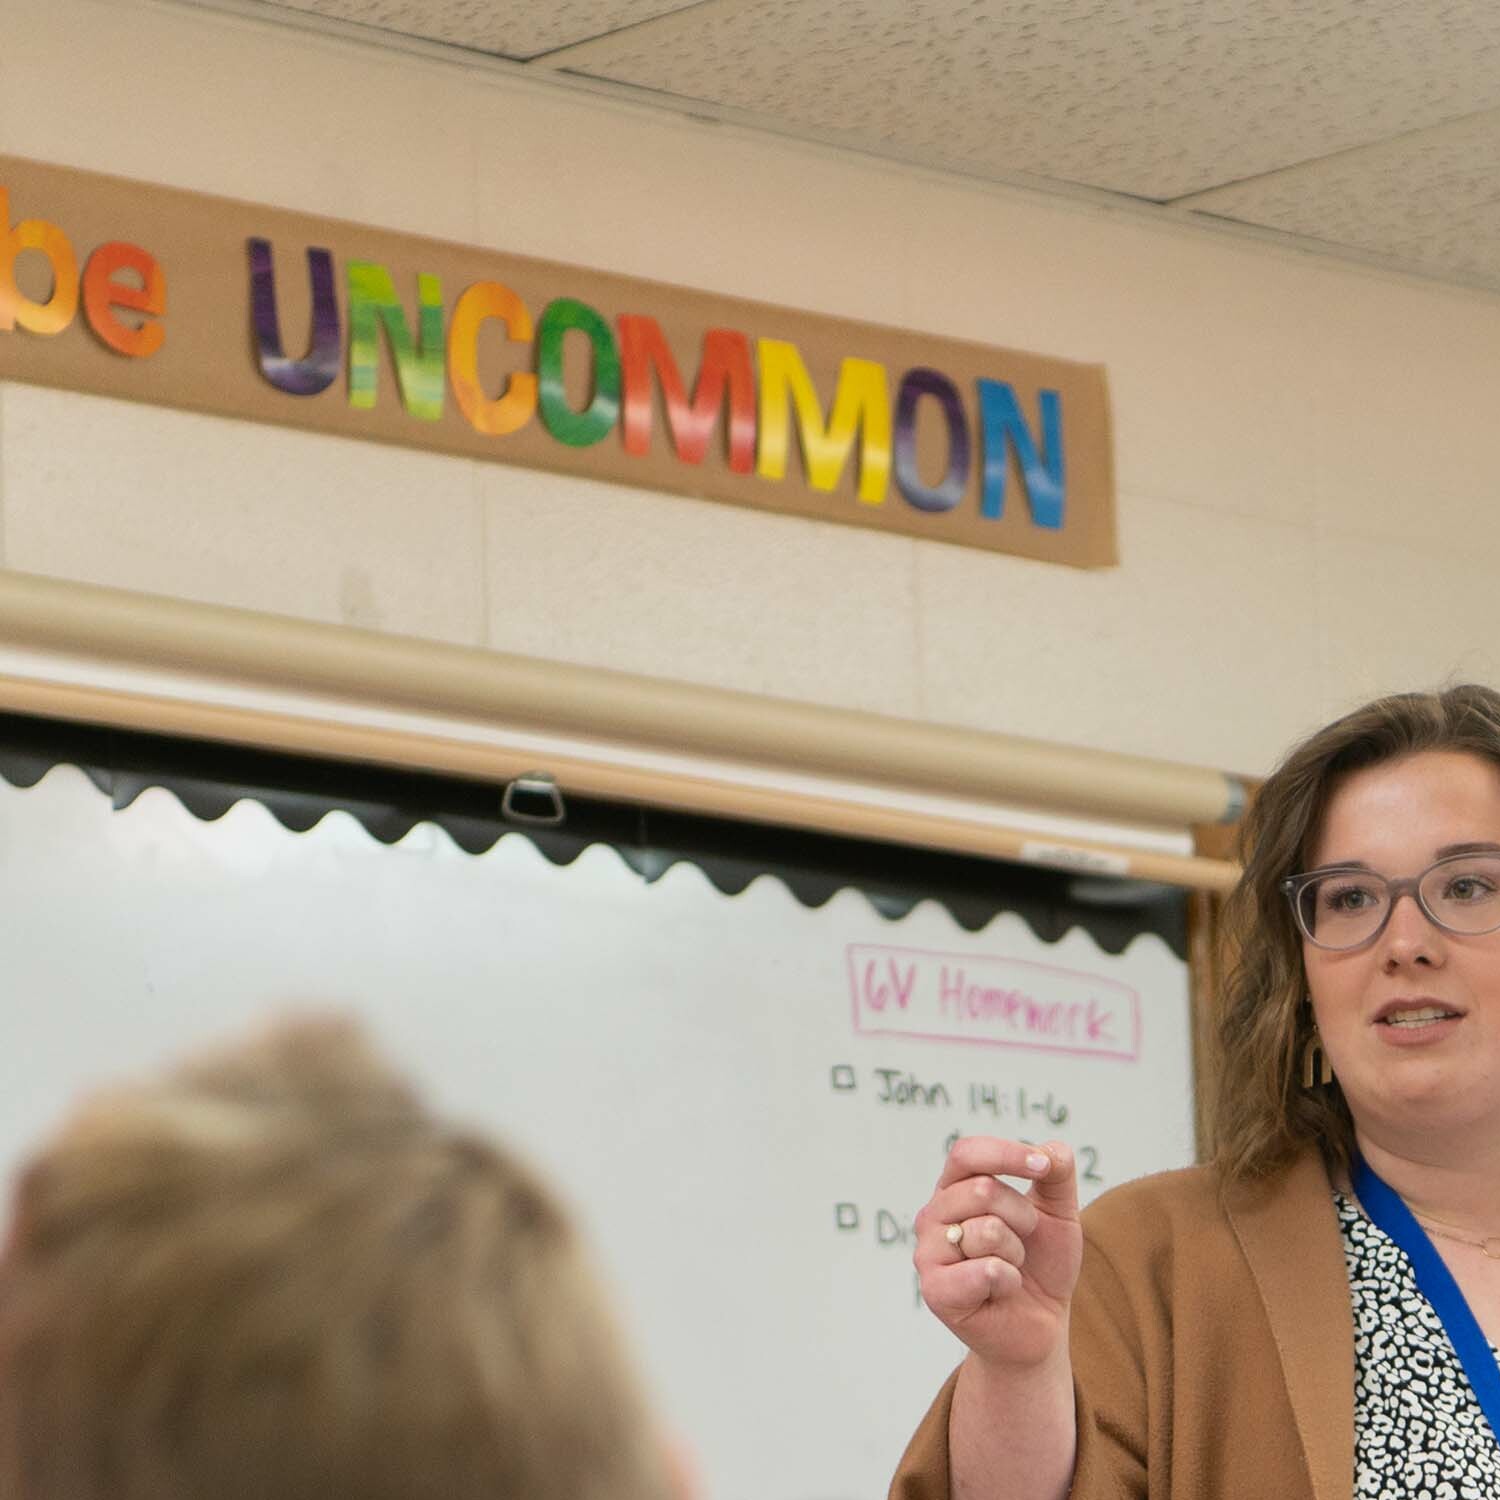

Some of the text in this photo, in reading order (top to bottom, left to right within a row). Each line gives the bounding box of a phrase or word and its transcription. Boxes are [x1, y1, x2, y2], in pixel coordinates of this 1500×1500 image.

[0, 186, 1066, 531] be UNCOMMON
[864, 957, 1118, 1040] 6V Homework
[874, 1067, 951, 1107] John
